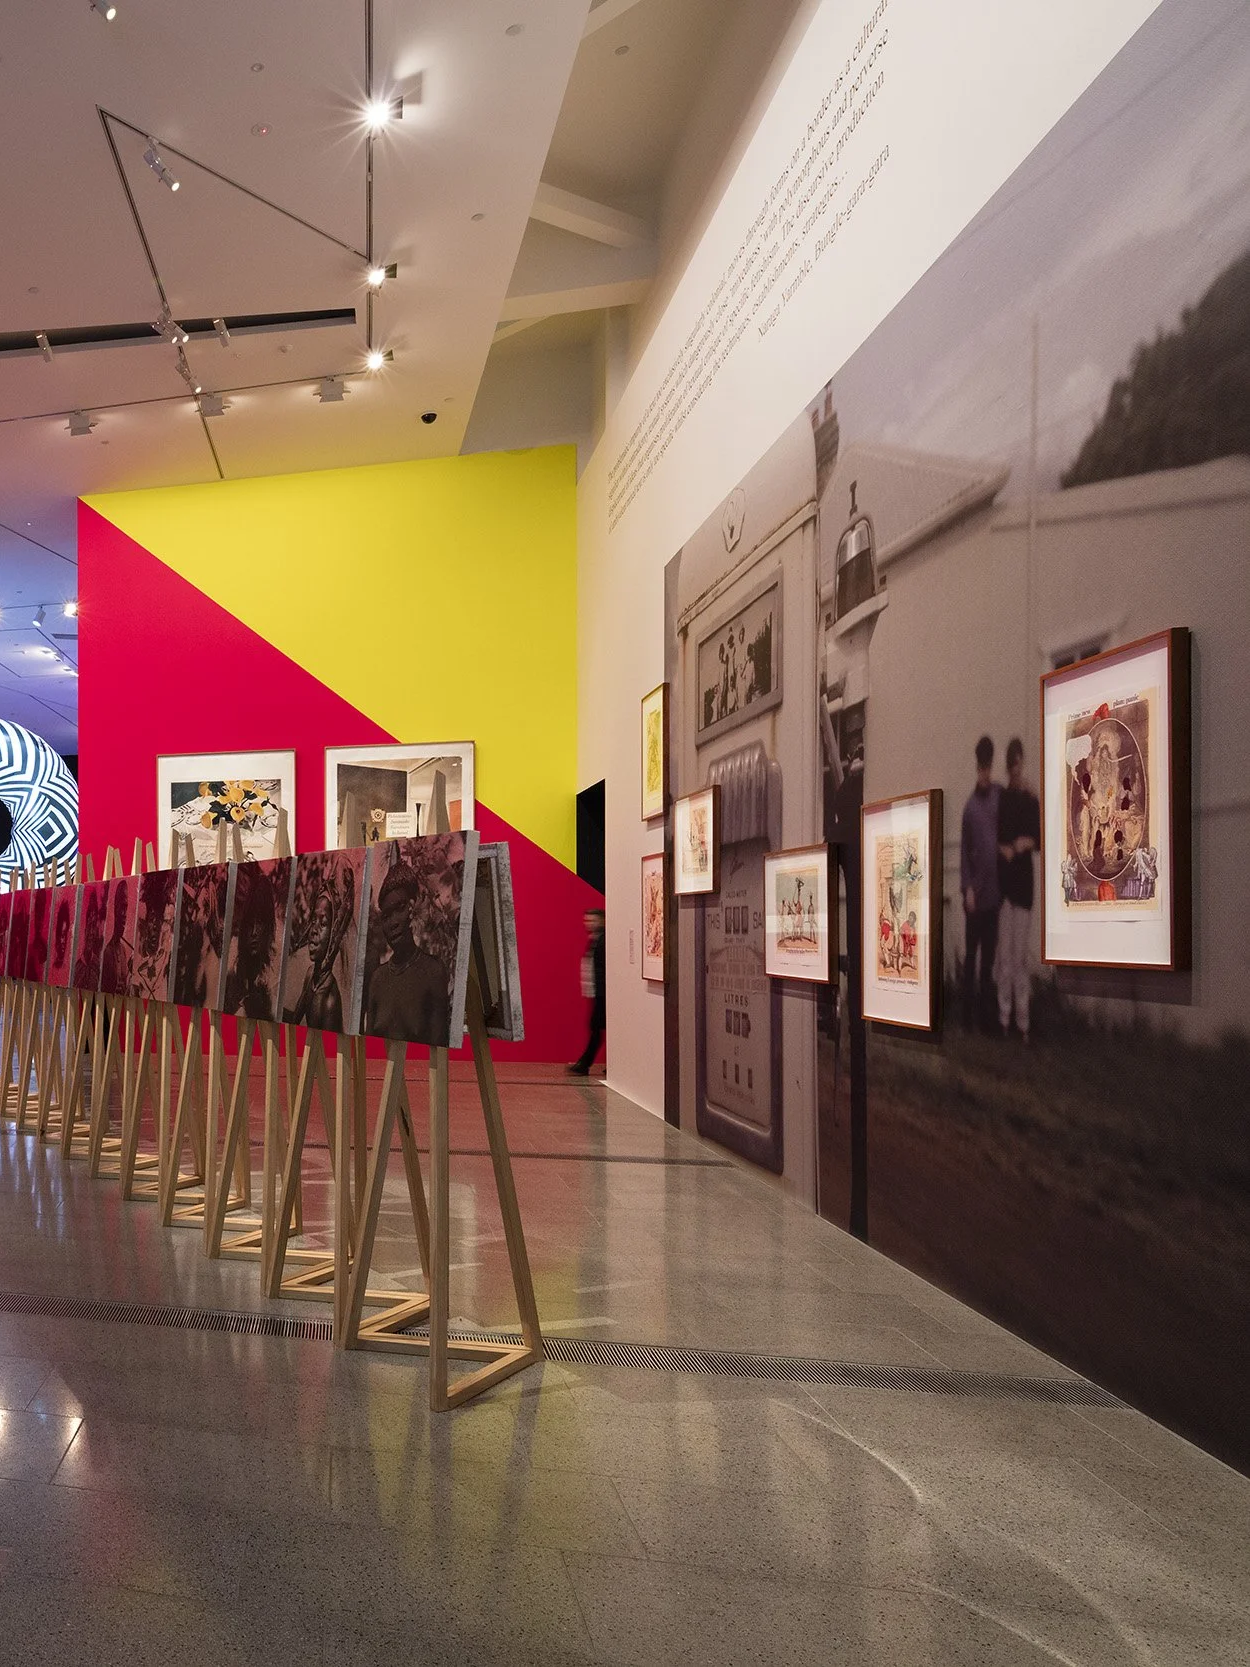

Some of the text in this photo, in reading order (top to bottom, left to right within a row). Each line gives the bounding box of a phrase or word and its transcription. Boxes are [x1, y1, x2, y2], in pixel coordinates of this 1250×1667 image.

[728, 241, 745, 279] moves
[745, 195, 768, 245] through
[770, 165, 788, 206] forms
[791, 147, 800, 169] on
[807, 89, 832, 142] border
[834, 71, 843, 95] as
[763, 208, 777, 242] with
[779, 124, 830, 223] polymorphous
[832, 86, 847, 131] and
[848, 28, 888, 109] perverse
[781, 214, 794, 242] The
[795, 150, 834, 220] discursive
[836, 72, 884, 161] production
[1126, 694, 1139, 704] panic
[724, 994, 749, 1007] LITRES
